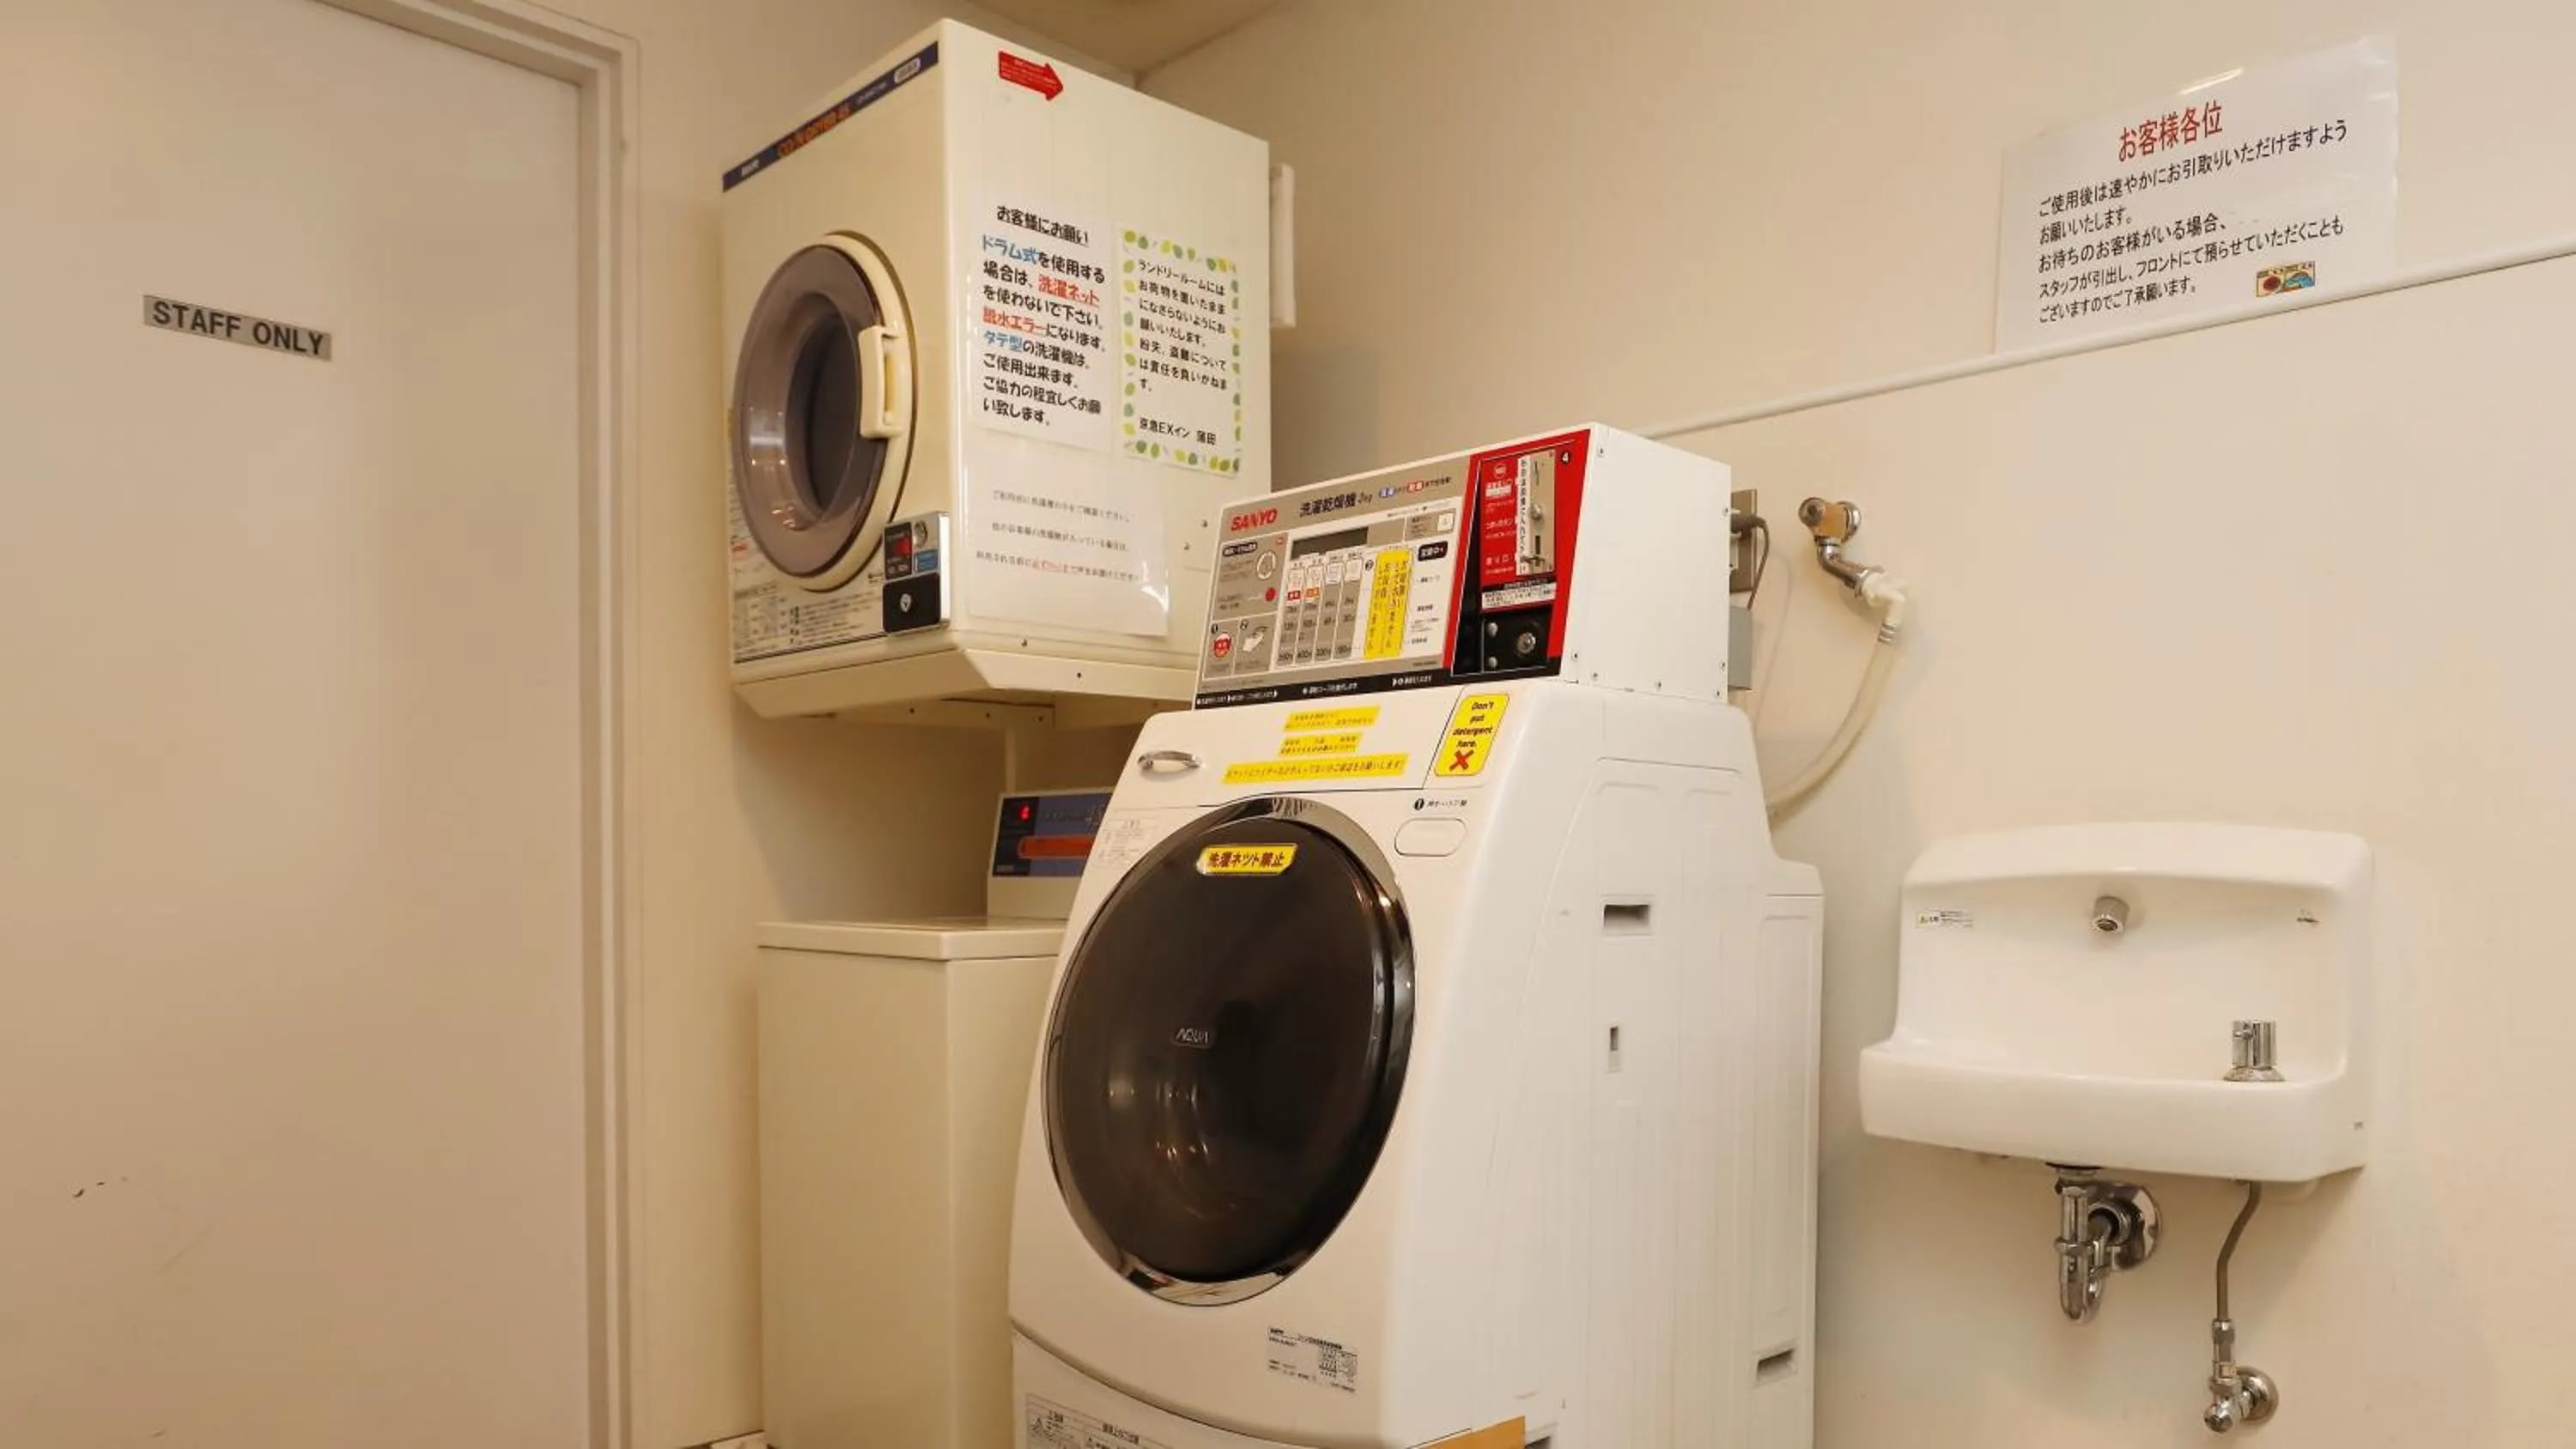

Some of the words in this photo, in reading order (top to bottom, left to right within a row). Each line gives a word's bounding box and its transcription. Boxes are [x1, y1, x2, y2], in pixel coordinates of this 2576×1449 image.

[2117, 99, 2224, 163] お客様各位
[2039, 118, 2348, 218] ご使用後は速やかにお引取りいただけますよう
[997, 205, 1088, 246] お客様にお願い
[2038, 212, 2227, 274] お待ちのお客様がいる場合、
[2039, 206, 2132, 246] お願いいたします。
[983, 233, 1105, 284] ドラム式を使用する
[1139, 259, 1225, 296] ランドリールームには
[983, 284, 1103, 330] を使わないで下さい。
[1139, 280, 1225, 315] お荷物を置いたまま
[1139, 298, 1226, 334] になさらないようにお
[2039, 276, 2196, 324] ございますのでご了承願います。
[153, 300, 241, 337] STAFF
[252, 322, 325, 355] ONLY
[983, 306, 1106, 353] 脱水エラーになります。
[1139, 318, 1206, 348] 願いいたします。
[983, 353, 1078, 389] ご使用出来ます。
[1139, 378, 1152, 392] す。
[983, 375, 1102, 415] ご協力の程宜しくお願
[983, 397, 1050, 427] い致します。
[1563, 452, 1570, 464] 4
[1230, 508, 1278, 531] SANYO
[1472, 701, 1494, 710] Don't
[1453, 726, 1492, 736] detergent
[1207, 851, 1285, 868] 洗濯ネット禁止
